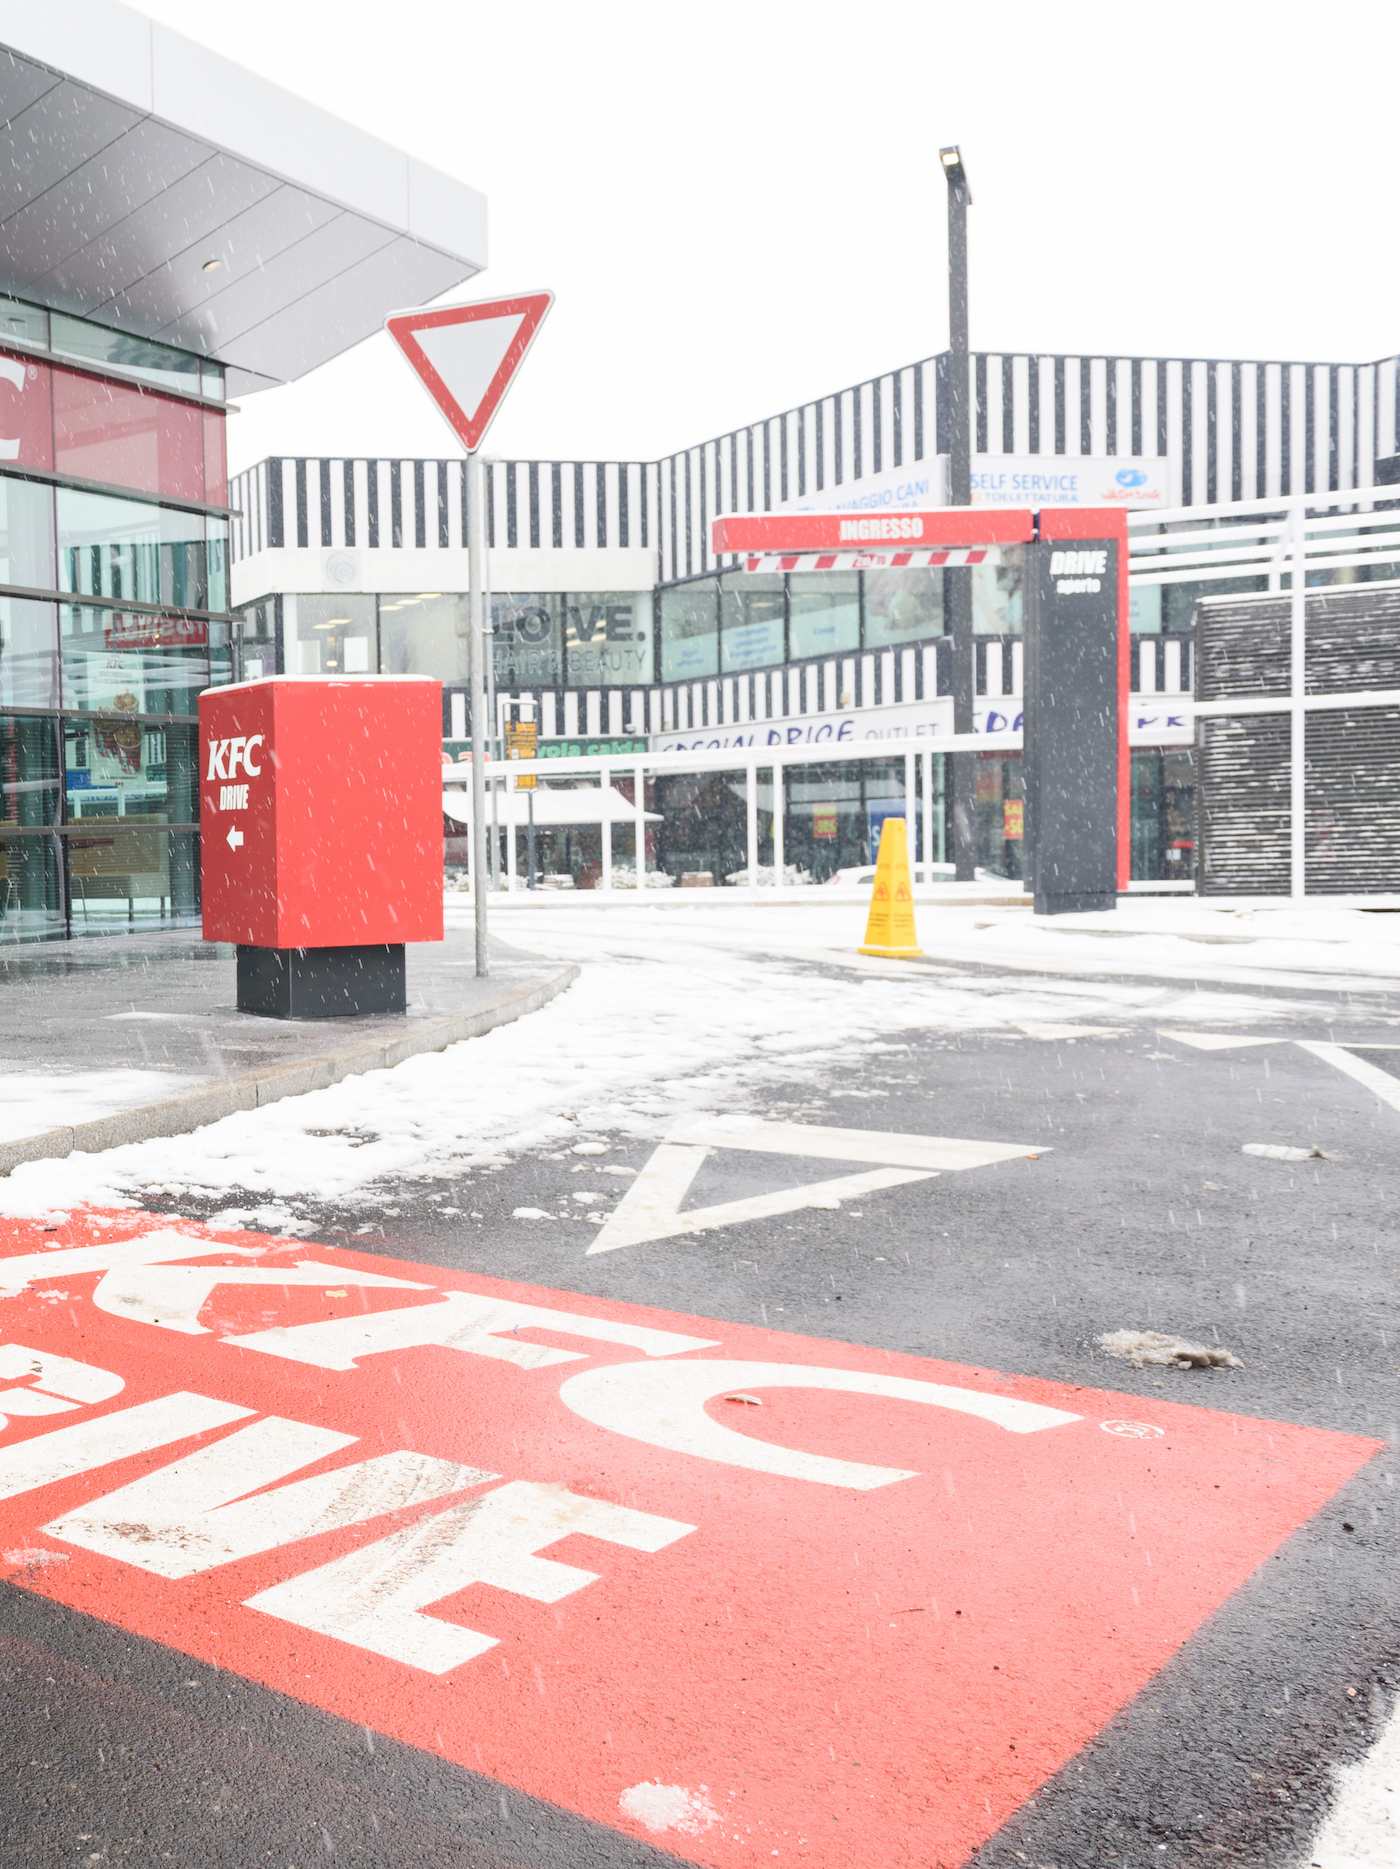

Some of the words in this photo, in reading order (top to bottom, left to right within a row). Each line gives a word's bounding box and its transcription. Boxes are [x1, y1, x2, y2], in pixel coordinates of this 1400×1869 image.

[897, 478, 929, 501] CANI
[970, 474, 1006, 490] SELF
[1012, 474, 1078, 491] SERVICE
[985, 492, 1079, 502] TOELETTATURA
[840, 517, 924, 540] INGRESSO
[1049, 550, 1108, 575] DRIVE
[1056, 577, 1101, 595] aperto
[106, 659, 124, 669] KFC
[570, 650, 647, 672] BEAUTY
[206, 734, 263, 781] KFC
[587, 740, 646, 757] calda
[220, 784, 250, 811] DRIVE
